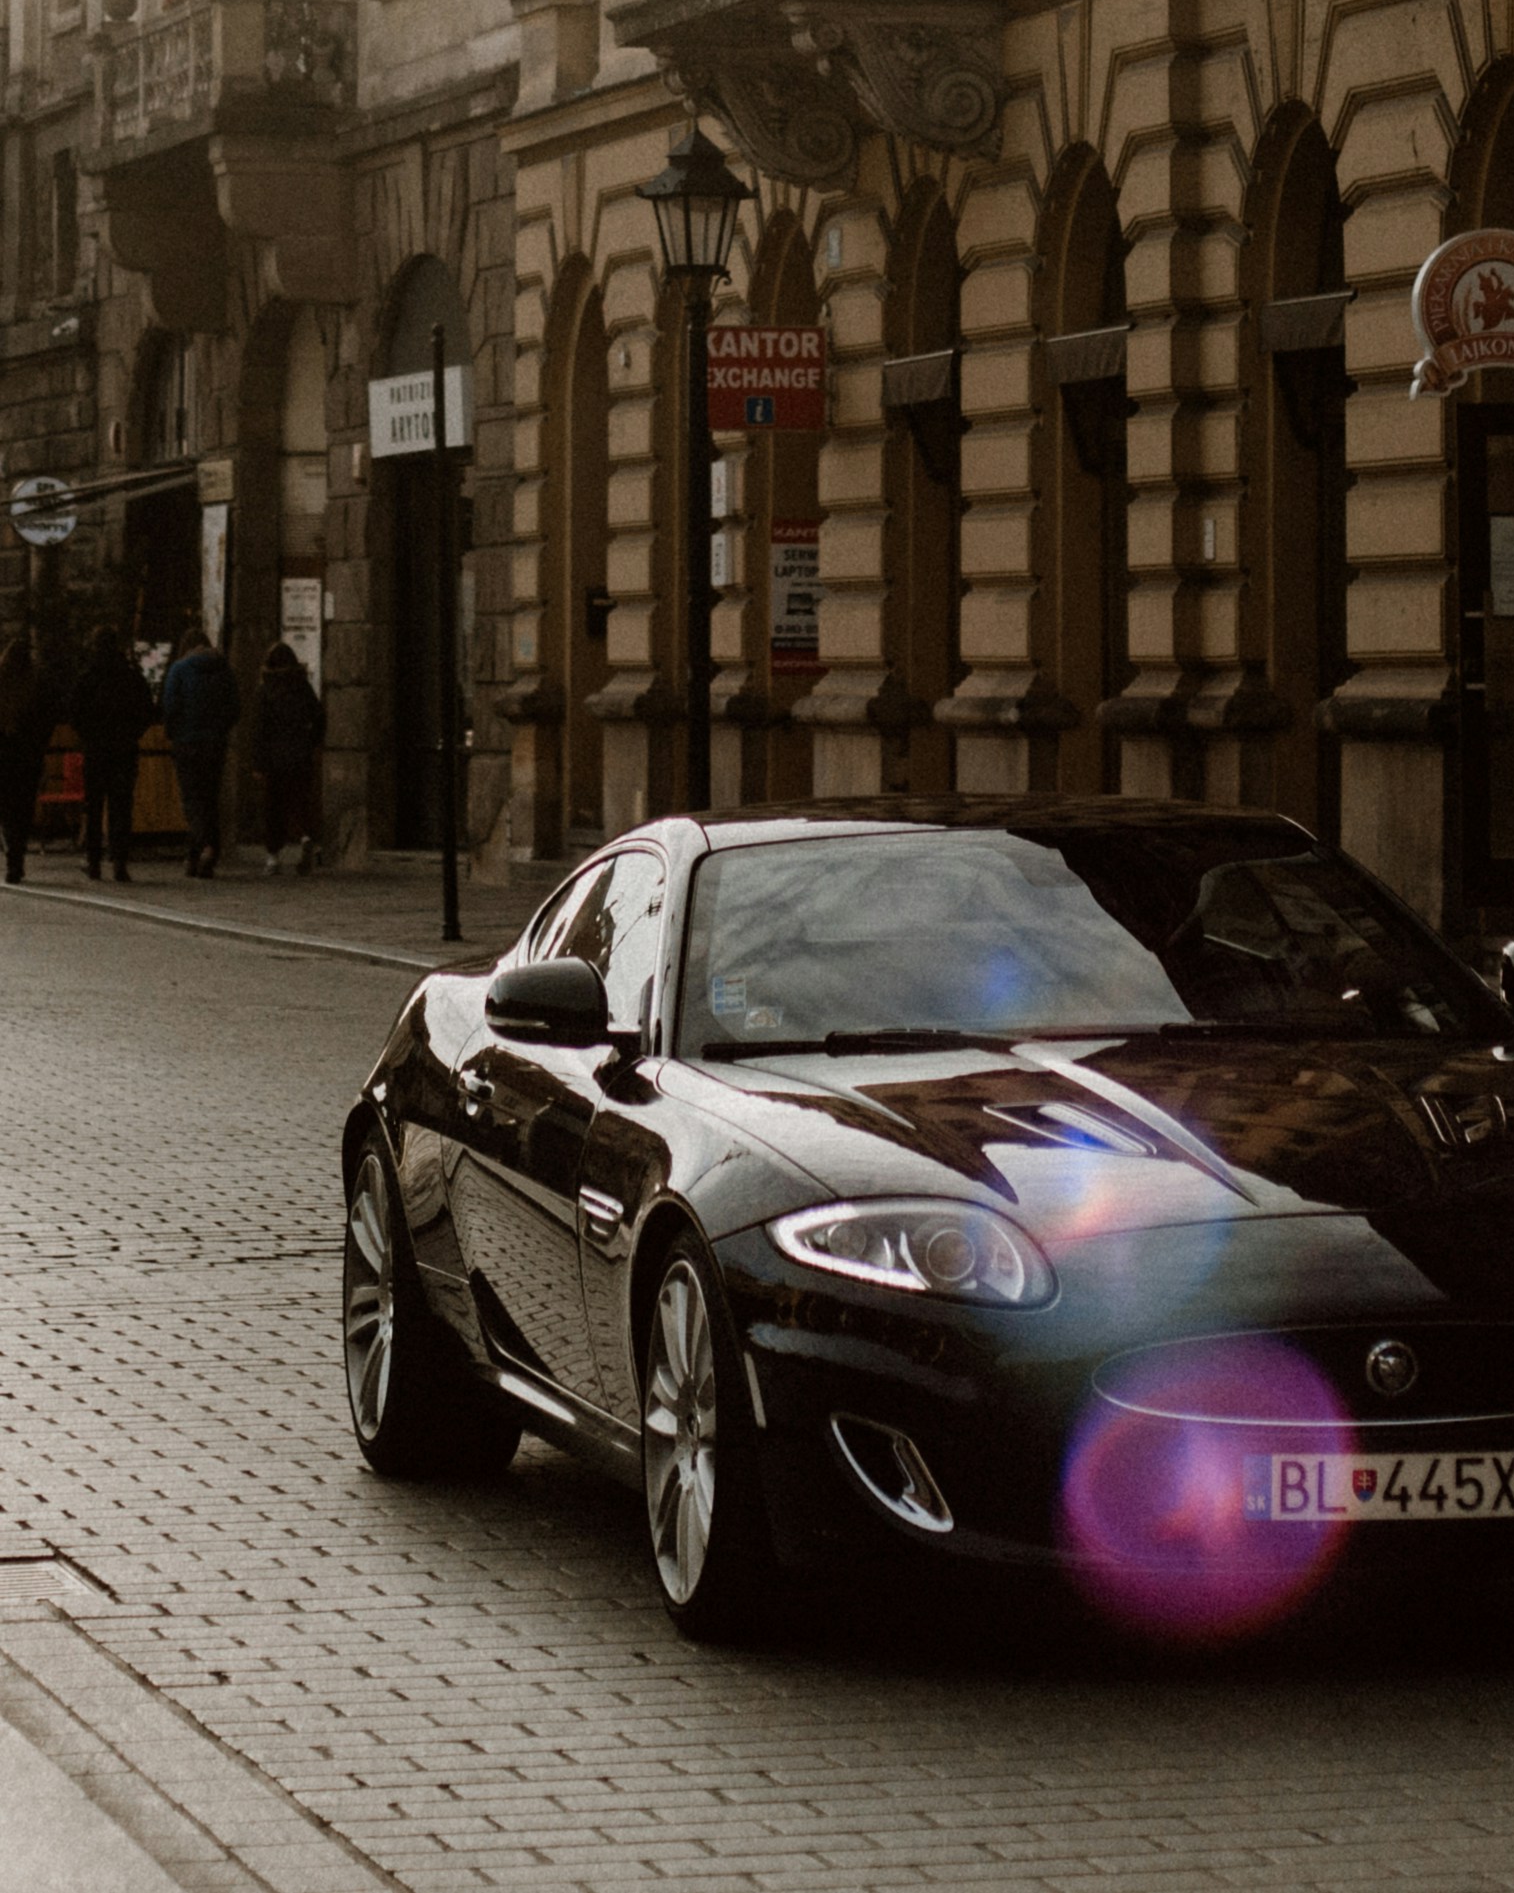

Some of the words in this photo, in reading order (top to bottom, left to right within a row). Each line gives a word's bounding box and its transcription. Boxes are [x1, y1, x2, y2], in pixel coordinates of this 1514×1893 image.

[1430, 241, 1485, 333] PIEKARNIA
[389, 381, 434, 405] PATRIZI
[390, 411, 434, 444] ARYTO
[1281, 1460, 1347, 1514] BL
